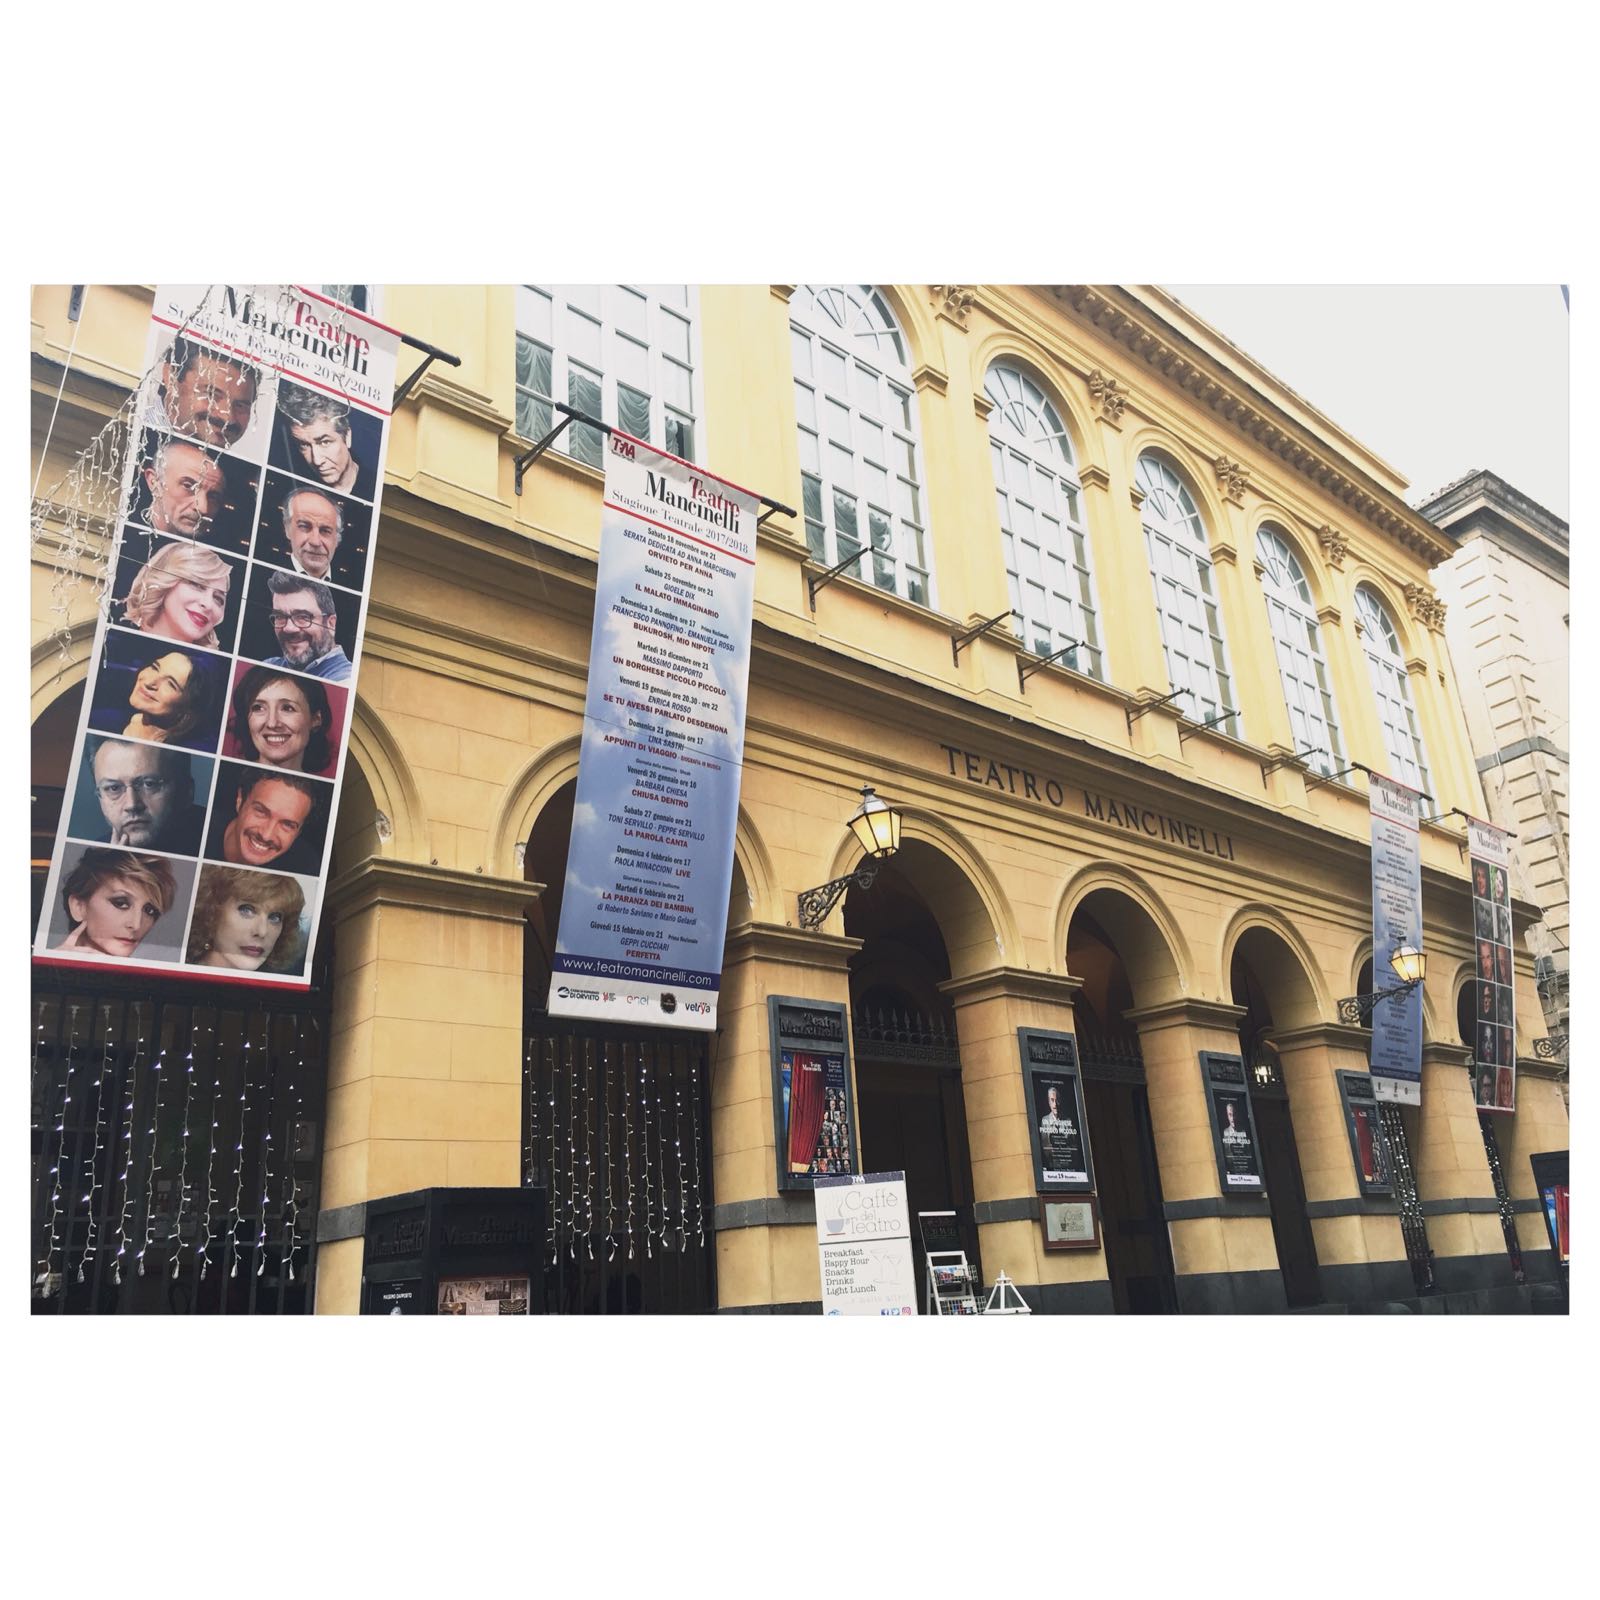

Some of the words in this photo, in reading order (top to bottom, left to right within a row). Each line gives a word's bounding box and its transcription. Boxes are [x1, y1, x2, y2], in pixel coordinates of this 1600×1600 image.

[222, 285, 368, 376] Mancinelli
[314, 363, 381, 401] 2017/2018
[645, 470, 739, 534] Mancinelli
[689, 476, 740, 517] Teatro
[613, 489, 658, 515] Stagione
[662, 508, 703, 533] Teatrale
[706, 528, 748, 554] 2017/2018
[624, 529, 646, 545] SERATA
[648, 539, 676, 555] DEDICATA
[677, 550, 685, 558] AD
[687, 554, 702, 566] ANNA
[703, 560, 736, 578] MARCHESINI
[648, 528, 666, 540] Sabato
[667, 534, 674, 543] 18
[676, 538, 699, 554] novembre
[701, 548, 709, 557] ore
[710, 551, 716, 560] 21
[648, 549, 678, 565] ORVIETO
[680, 561, 693, 572] PER
[695, 568, 713, 579] ANNA
[645, 565, 663, 577] Sabato
[664, 572, 671, 580] 25
[672, 576, 696, 589] novembre
[644, 586, 671, 601] MALATO
[674, 597, 719, 618] IMMAGINARIO
[664, 583, 684, 596] GIOELE
[685, 591, 695, 600] DIX
[621, 596, 647, 611] Domenica
[654, 607, 678, 621] dicembre
[689, 619, 696, 627] 17
[612, 605, 649, 622] FRANCESCO
[651, 617, 683, 634] PANNOFINO
[688, 630, 717, 647] EMANUELA
[719, 641, 735, 652] ROSSI
[633, 622, 674, 642] BUKUROSH,
[676, 637, 690, 646] MIO
[691, 642, 714, 655] NIPOTE
[643, 654, 671, 669] MASSIMO
[673, 663, 703, 678] DAPPORTO
[660, 648, 666, 656] 19
[668, 651, 691, 664] dicembre
[693, 660, 701, 668] ore
[702, 662, 709, 670] 21
[613, 656, 624, 665] UN
[626, 659, 664, 677] BORGHESE
[667, 672, 696, 686] PICCOLO
[698, 682, 726, 696] PICCOLO
[642, 682, 649, 690] 19
[650, 685, 671, 697] gennaio
[683, 694, 697, 704] 20.30
[603, 694, 613, 702] SE
[616, 697, 624, 705] TU
[626, 700, 652, 713] AVESSI
[655, 708, 685, 722] PARLATO
[687, 717, 728, 734] DESDEMONA
[648, 696, 670, 709] ENRICA
[672, 702, 691, 713] ROSSO
[629, 719, 655, 732] Domenica
[665, 728, 686, 741] gennaio
[687, 735, 695, 743] ore
[697, 737, 703, 745] 17
[603, 735, 636, 749] APPUNTI
[638, 743, 645, 751] DI
[648, 746, 677, 759] VIAGGIO
[663, 738, 684, 750] SASTRI
[636, 779, 664, 792] BARBARA
[666, 787, 687, 797] CHIESA
[649, 771, 656, 779] 26
[658, 773, 678, 784] gennaio
[632, 789, 659, 801] CHIUSA
[661, 796, 688, 808] DENTRO
[940, 744, 1064, 808] TEATRO
[1082, 790, 1236, 861] MANCINELLI
[624, 805, 643, 816] Sabato
[653, 812, 674, 823] gennaio
[608, 814, 623, 823] TONI
[624, 818, 653, 830] SERVILLO
[658, 824, 676, 835] PEPPE
[678, 830, 705, 841] SERVILLO
[636, 831, 663, 842] PAROLA
[666, 838, 688, 848] CANTA
[617, 845, 644, 857] Domenica
[651, 852, 672, 862] febbraio
[615, 857, 634, 868] PAOLA
[636, 861, 672, 874] MINACCIONI
[676, 869, 691, 878] LIVE
[602, 892, 611, 900] LA
[614, 895, 648, 906] PARANZA
[664, 903, 694, 913] BAMBINI
[644, 888, 666, 899] febbraio
[677, 894, 684, 902] 21
[597, 903, 602, 911] di
[605, 904, 629, 915] Roberto
[630, 909, 653, 919] Saviano
[660, 914, 675, 922] Mario
[613, 924, 620, 932] 15
[622, 926, 644, 936] febbraio
[621, 938, 639, 947] GEPPI
[641, 941, 669, 951] CUCCIARI
[626, 949, 661, 960] PERFETTA
[563, 958, 712, 986] www.teatromancinelli.com
[627, 995, 649, 1005] enel
[685, 1002, 710, 1014] vetrya
[845, 1188, 897, 1210] Caffè
[851, 1217, 900, 1234] Teatro
[862, 1210, 876, 1220] del
[824, 1249, 864, 1258] Breakfast
[825, 1260, 848, 1269] Happy
[826, 1278, 854, 1286] Drinks
[827, 1287, 848, 1296] Light
[850, 1285, 876, 1293] Lunch
